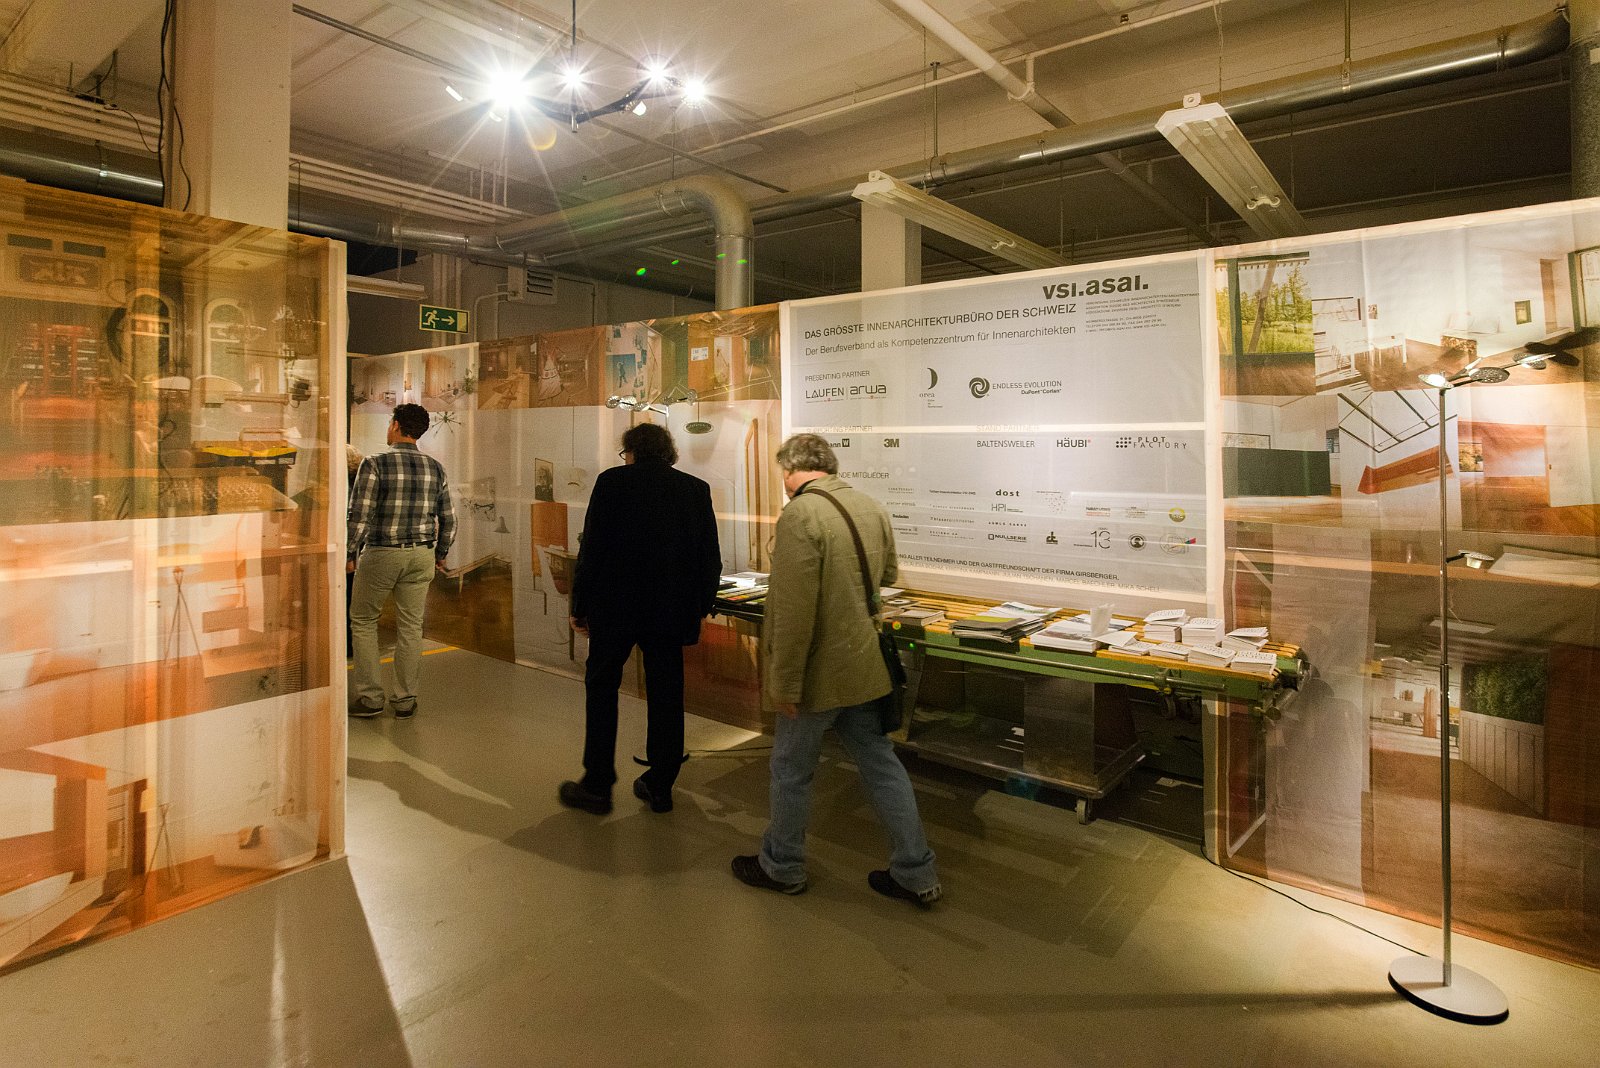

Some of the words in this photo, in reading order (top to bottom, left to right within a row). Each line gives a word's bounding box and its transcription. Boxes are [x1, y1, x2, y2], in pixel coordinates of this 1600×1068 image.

[804, 329, 821, 339] DAS
[823, 324, 864, 337] GRÖSSTE
[867, 312, 993, 331] INNENARCHITEKTURBÜRO
[996, 309, 1019, 320] DER
[1022, 303, 1077, 317] SCHWEIZ
[805, 347, 818, 356] Der
[820, 341, 875, 354] Berufsverband
[891, 333, 975, 347] Kompetenzzentrum
[977, 332, 989, 341] für
[992, 325, 1076, 340] Innenarchitekten
[805, 372, 841, 381] PRESENTING
[842, 370, 870, 378] PARTNER
[805, 387, 844, 399] LAUFEN
[849, 384, 887, 395] arwa
[992, 382, 1023, 390] ENDLESS
[1024, 380, 1062, 389] EVOLUTION
[884, 438, 899, 447] 3M
[976, 440, 1035, 448] BALTENSWEILER
[995, 489, 1020, 497] dost
[1090, 530, 1111, 549] 13
[923, 556, 956, 564] TEILNEHMER
[980, 562, 1041, 574] GASTFREUNDSCHAFT
